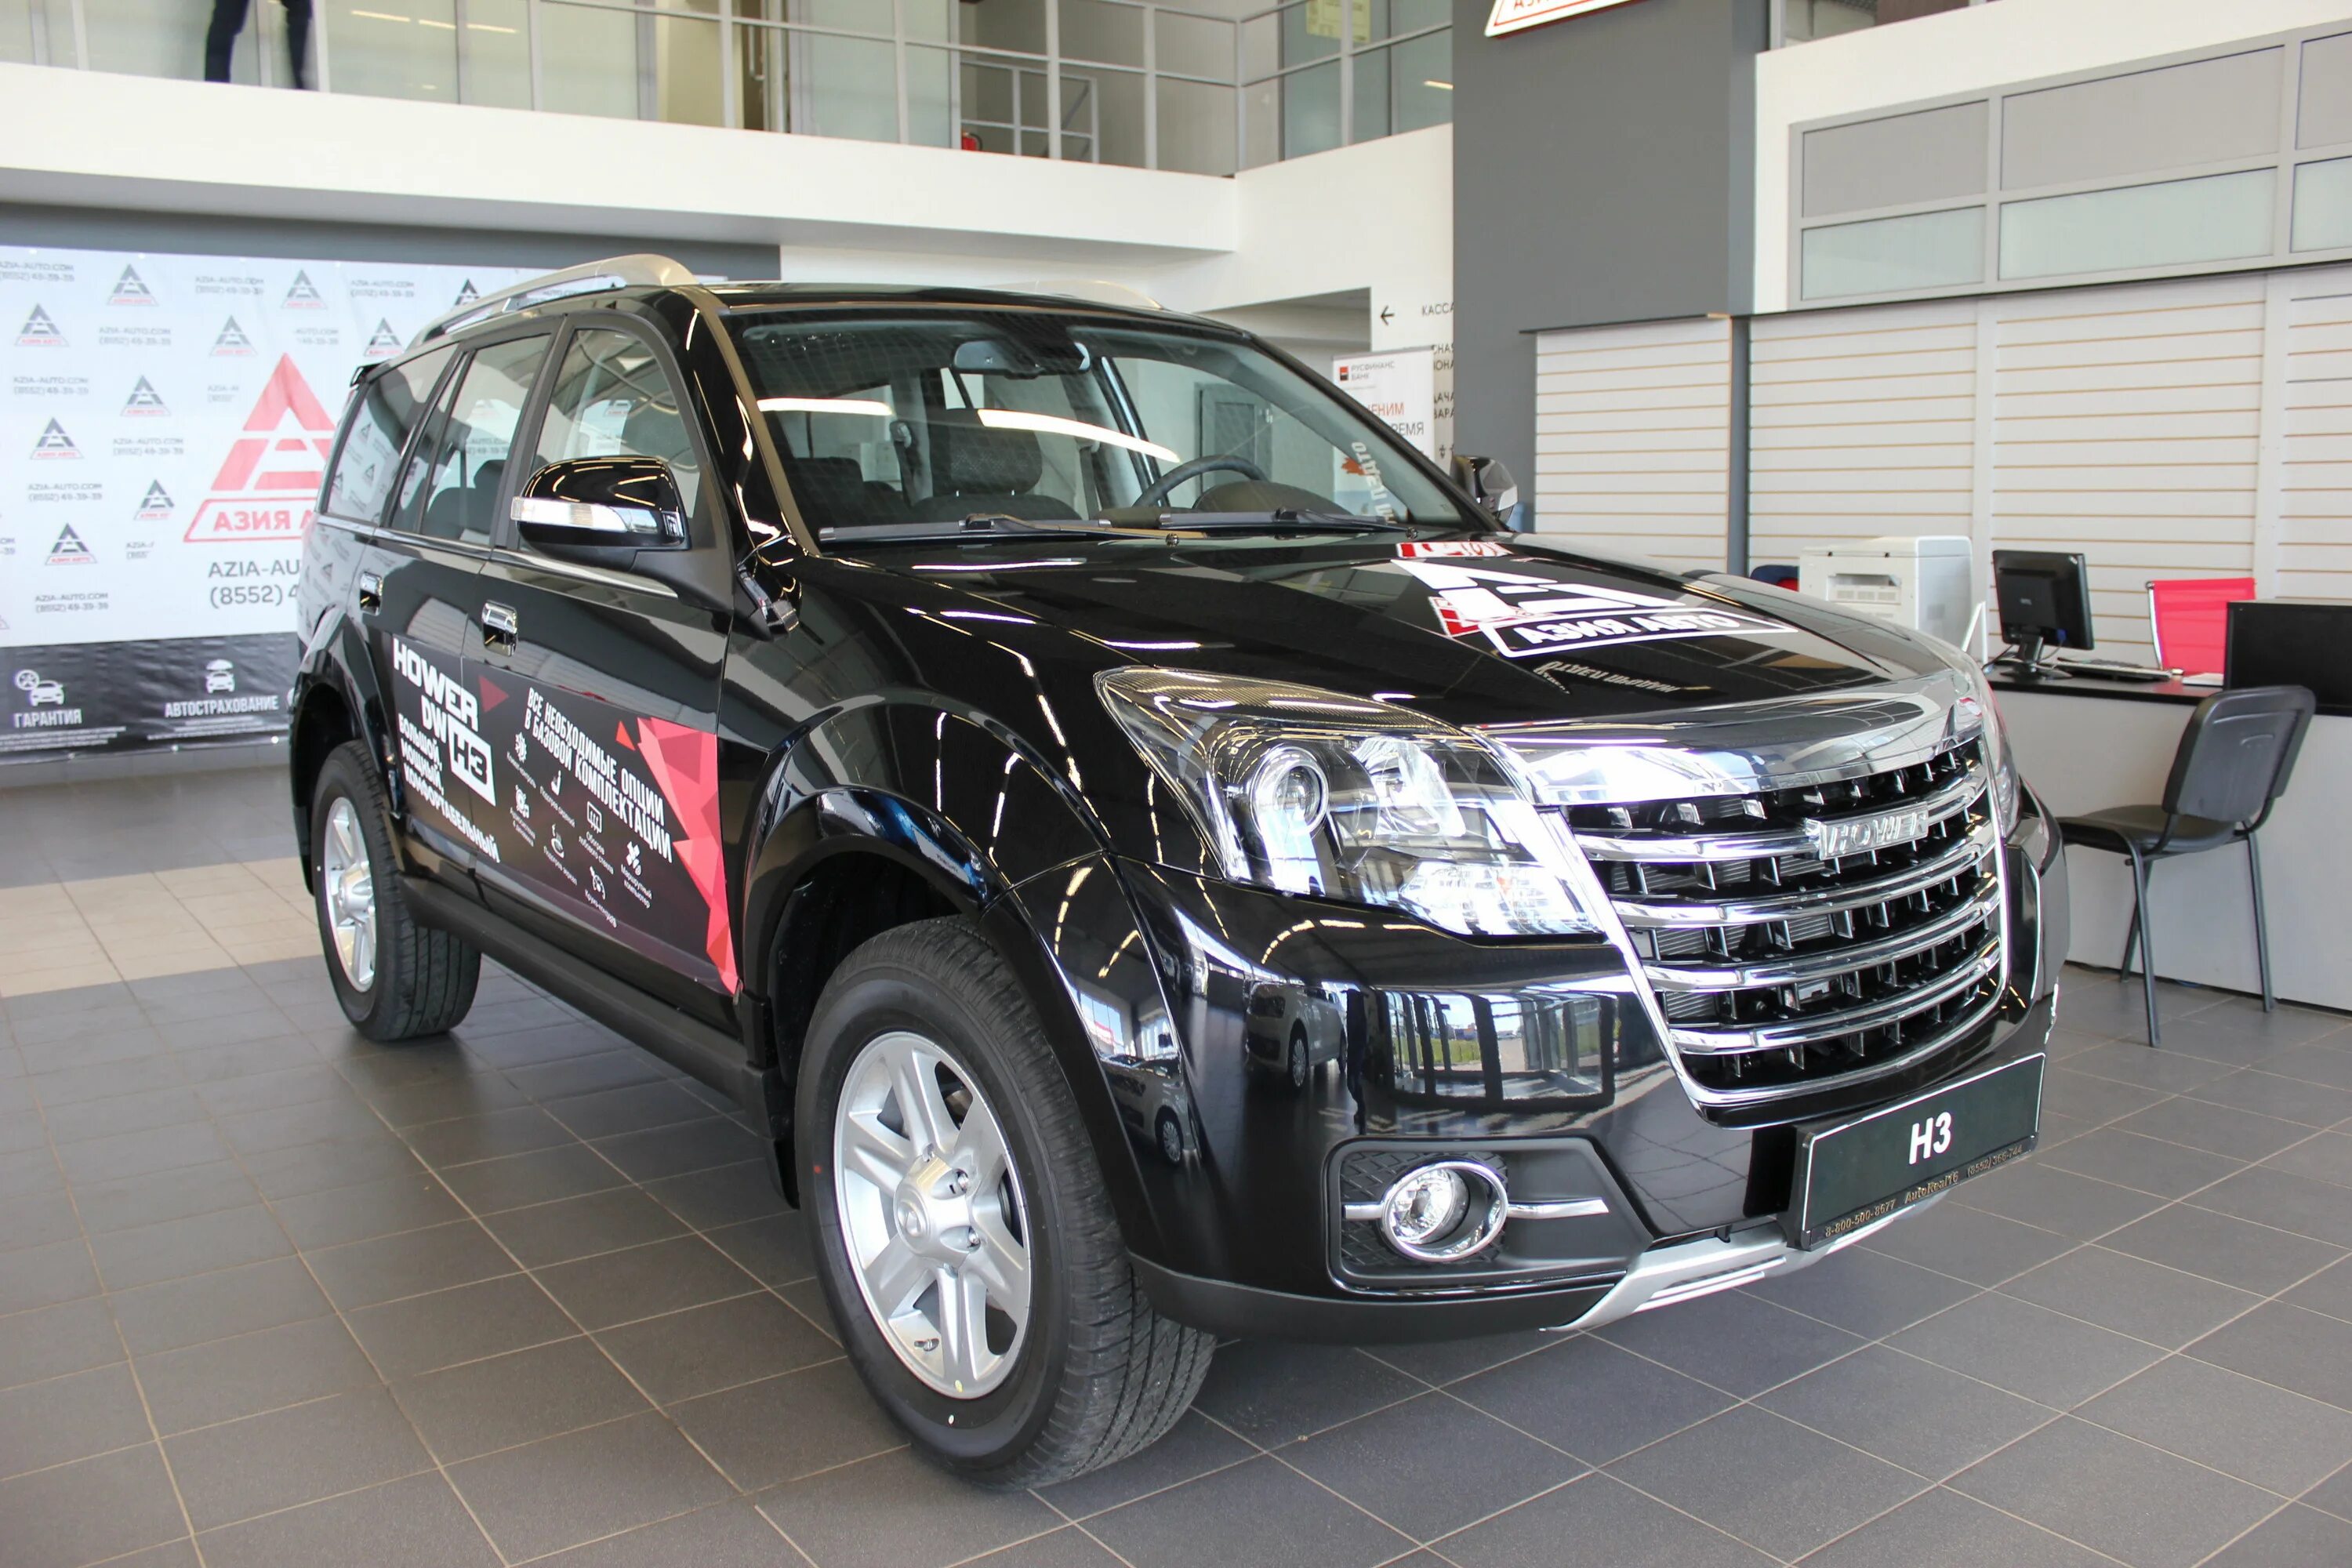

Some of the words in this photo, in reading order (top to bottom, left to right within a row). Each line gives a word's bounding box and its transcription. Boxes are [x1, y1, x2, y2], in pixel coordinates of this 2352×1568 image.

[213, 510, 291, 532] АЗИЯ
[209, 585, 283, 609] (8552)
[1513, 619, 1642, 644] АЗИЯ
[1630, 614, 1740, 632] АВТО
[165, 694, 279, 718] АВТОСТРАХОВАНИЕ
[394, 637, 479, 732] HOWER
[13, 708, 82, 728] ГАРАНТИЯ
[420, 695, 447, 744] DW
[527, 687, 544, 717] ВСЕ
[544, 702, 617, 786] НЕОБХОДИМЫЕ
[621, 768, 665, 826] ОПЦИИ
[524, 708, 532, 730] В
[532, 716, 572, 771] БАЗОВОЙ
[575, 753, 673, 863] КОМПЛЕКТАЦИИ
[403, 763, 501, 863] КОМФОРТАБЕЛЬНЫЙ
[1907, 1110, 1953, 1165] H3
[1824, 1198, 1896, 1238] 8-800-500-8677
[1904, 1170, 1960, 1205] AutoReal16
[1966, 1156, 1992, 1178] (8552)
